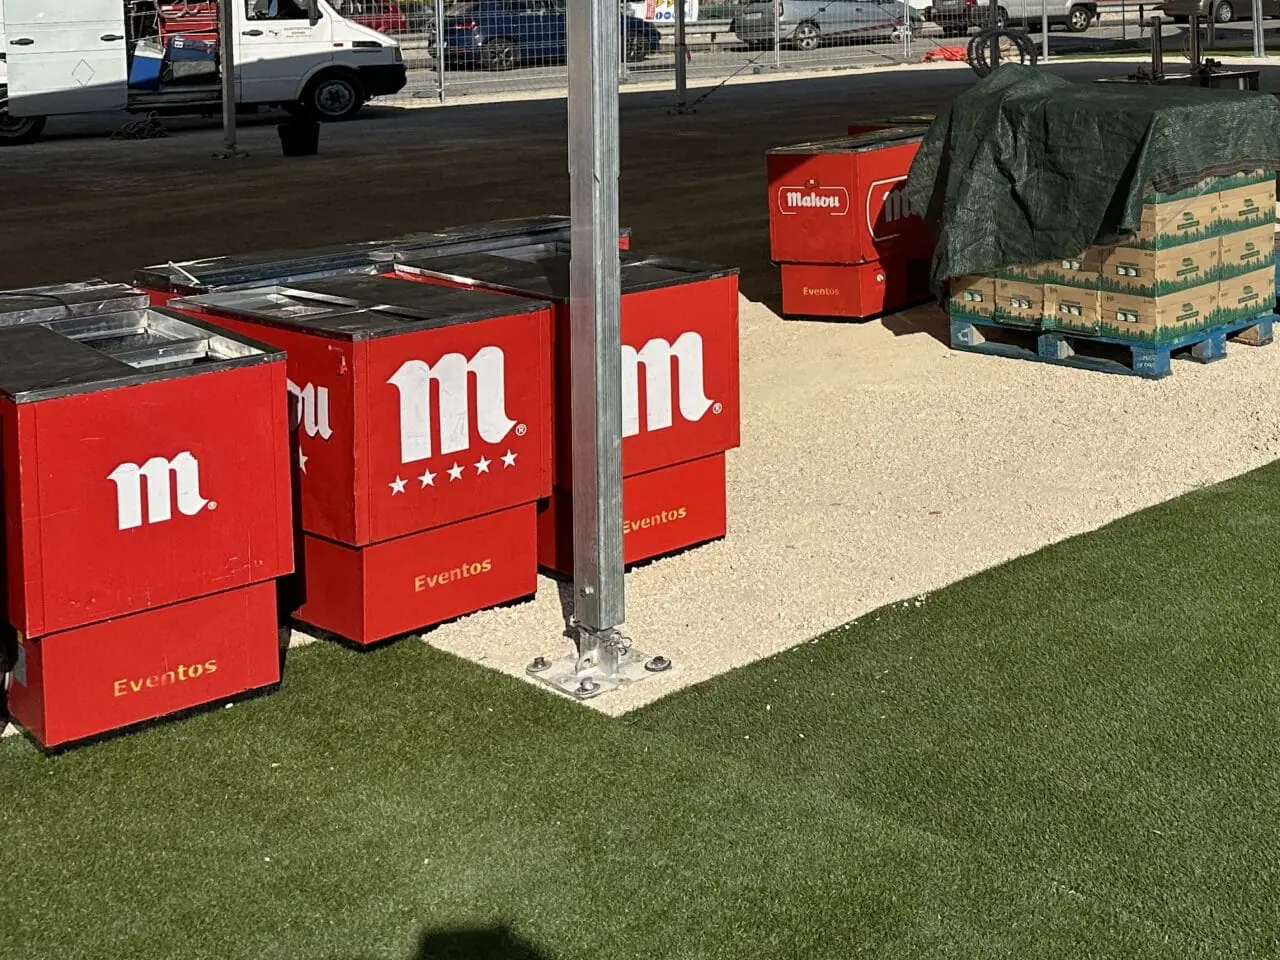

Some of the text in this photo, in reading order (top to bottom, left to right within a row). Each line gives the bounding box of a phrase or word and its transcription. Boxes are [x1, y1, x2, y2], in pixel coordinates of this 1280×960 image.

[786, 191, 841, 208] Mahou
[802, 287, 840, 297] Eventos
[623, 506, 688, 535] Eventos
[414, 558, 492, 593] Eventos
[113, 659, 218, 697] Eventos
